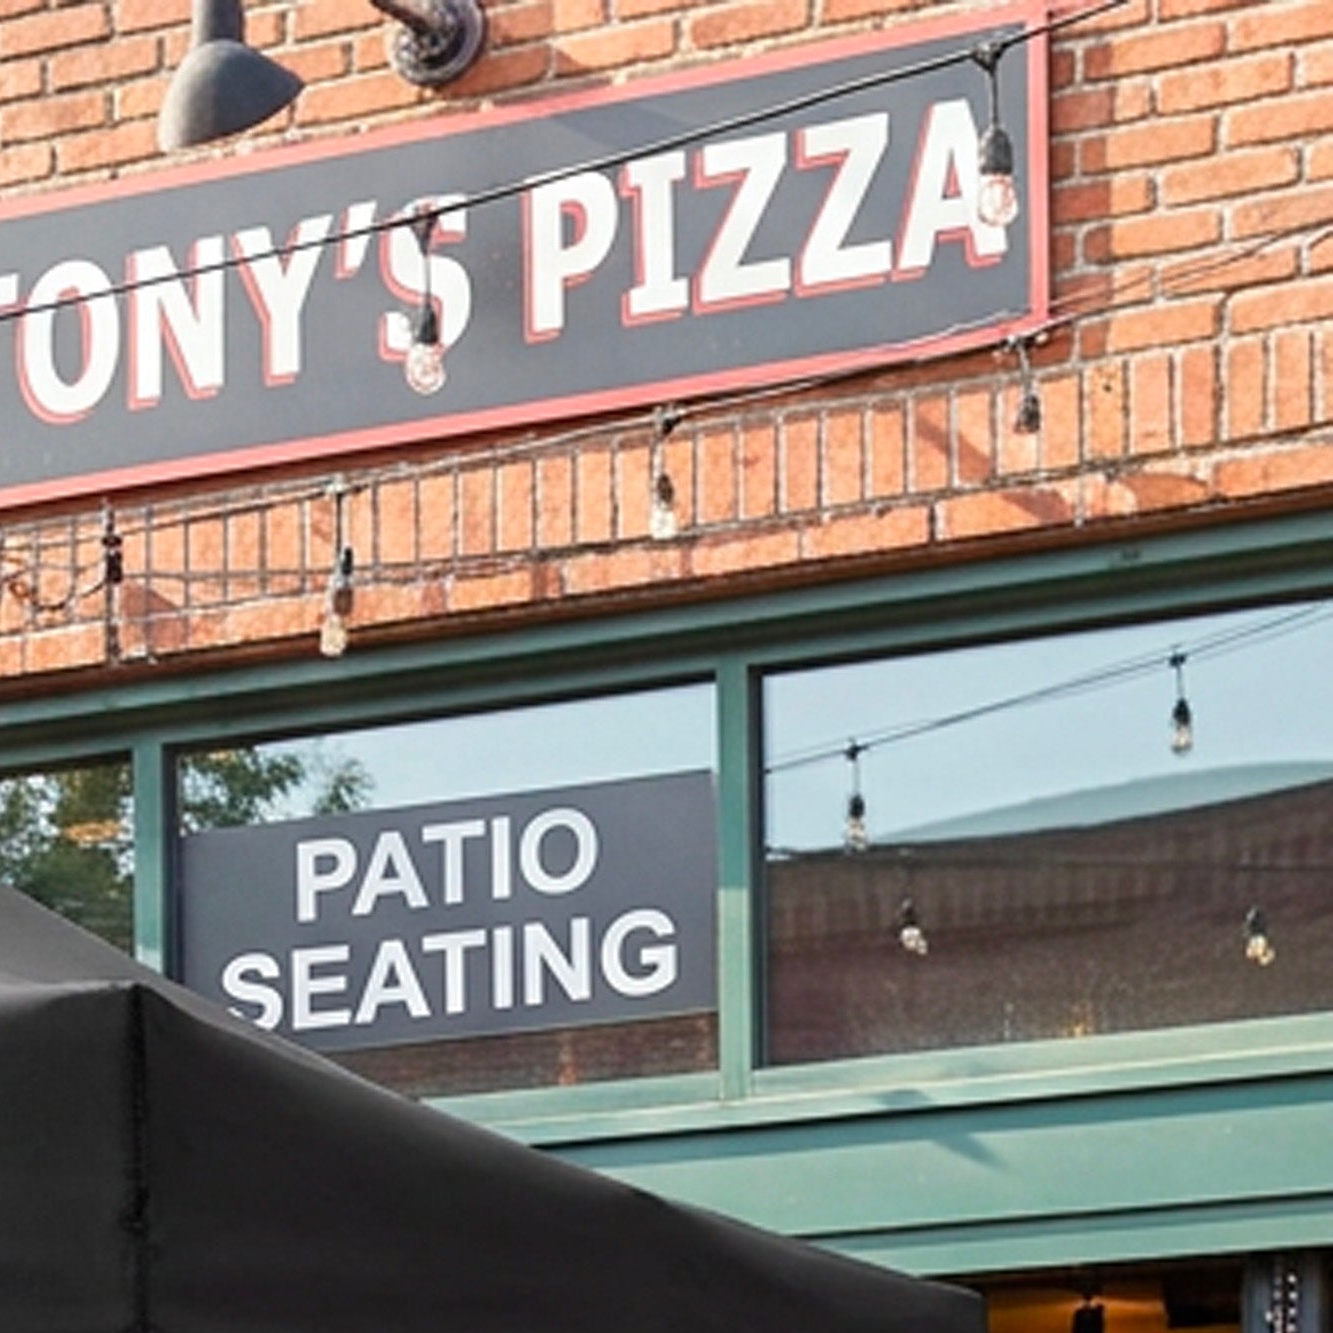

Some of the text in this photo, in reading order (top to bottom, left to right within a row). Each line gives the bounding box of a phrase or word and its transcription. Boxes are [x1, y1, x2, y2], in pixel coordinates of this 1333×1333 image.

[522, 96, 1013, 343] PIZZA
[294, 807, 598, 923] PATIO
[221, 907, 679, 1033] SEATING
